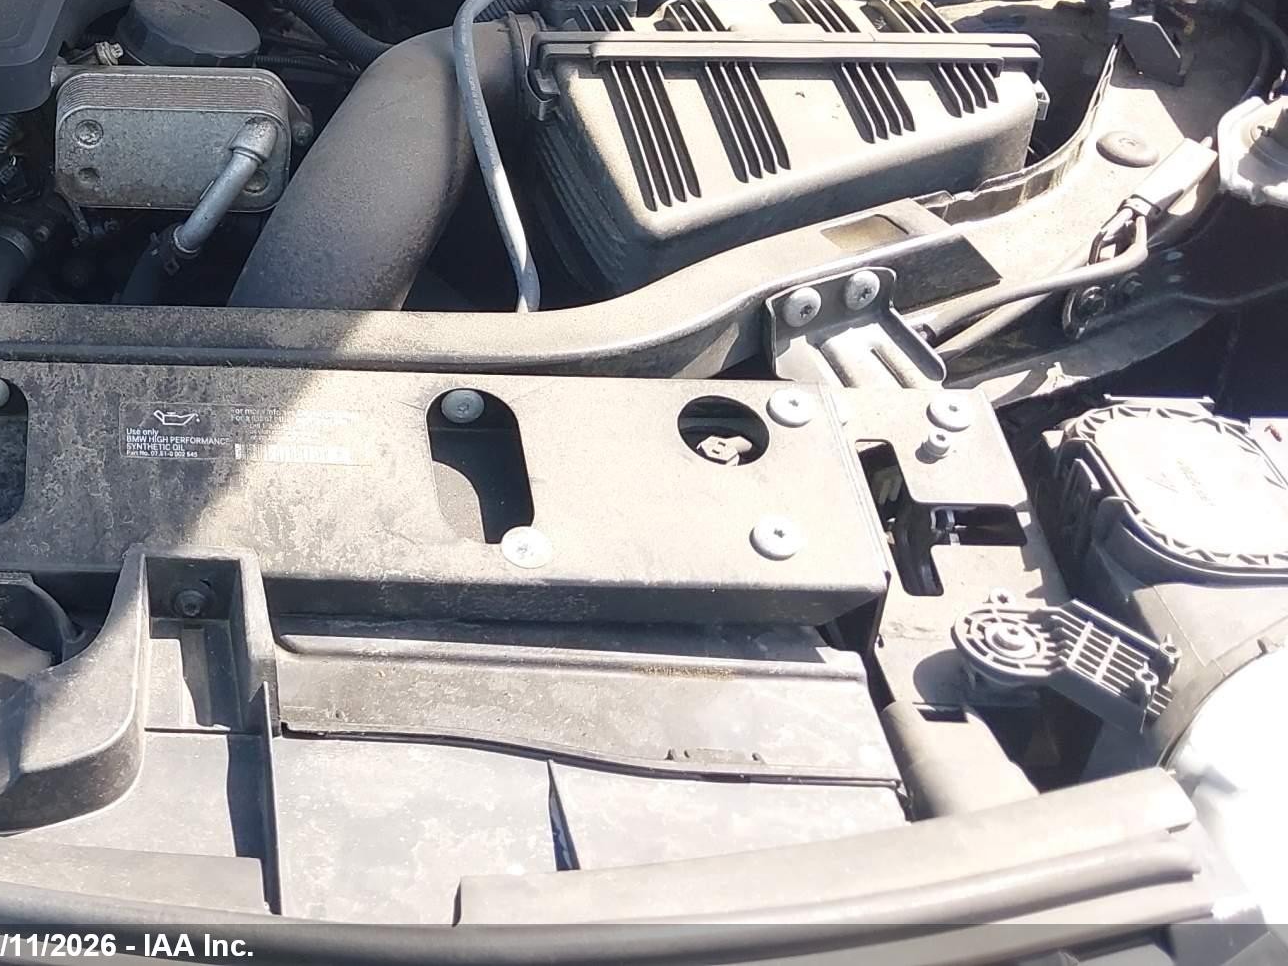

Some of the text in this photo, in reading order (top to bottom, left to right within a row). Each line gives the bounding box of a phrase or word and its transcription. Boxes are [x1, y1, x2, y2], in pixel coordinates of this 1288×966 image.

[142, 428, 159, 437] only
[170, 436, 230, 445] PERFORMANCE
[126, 443, 171, 451] SYNTHETIC
